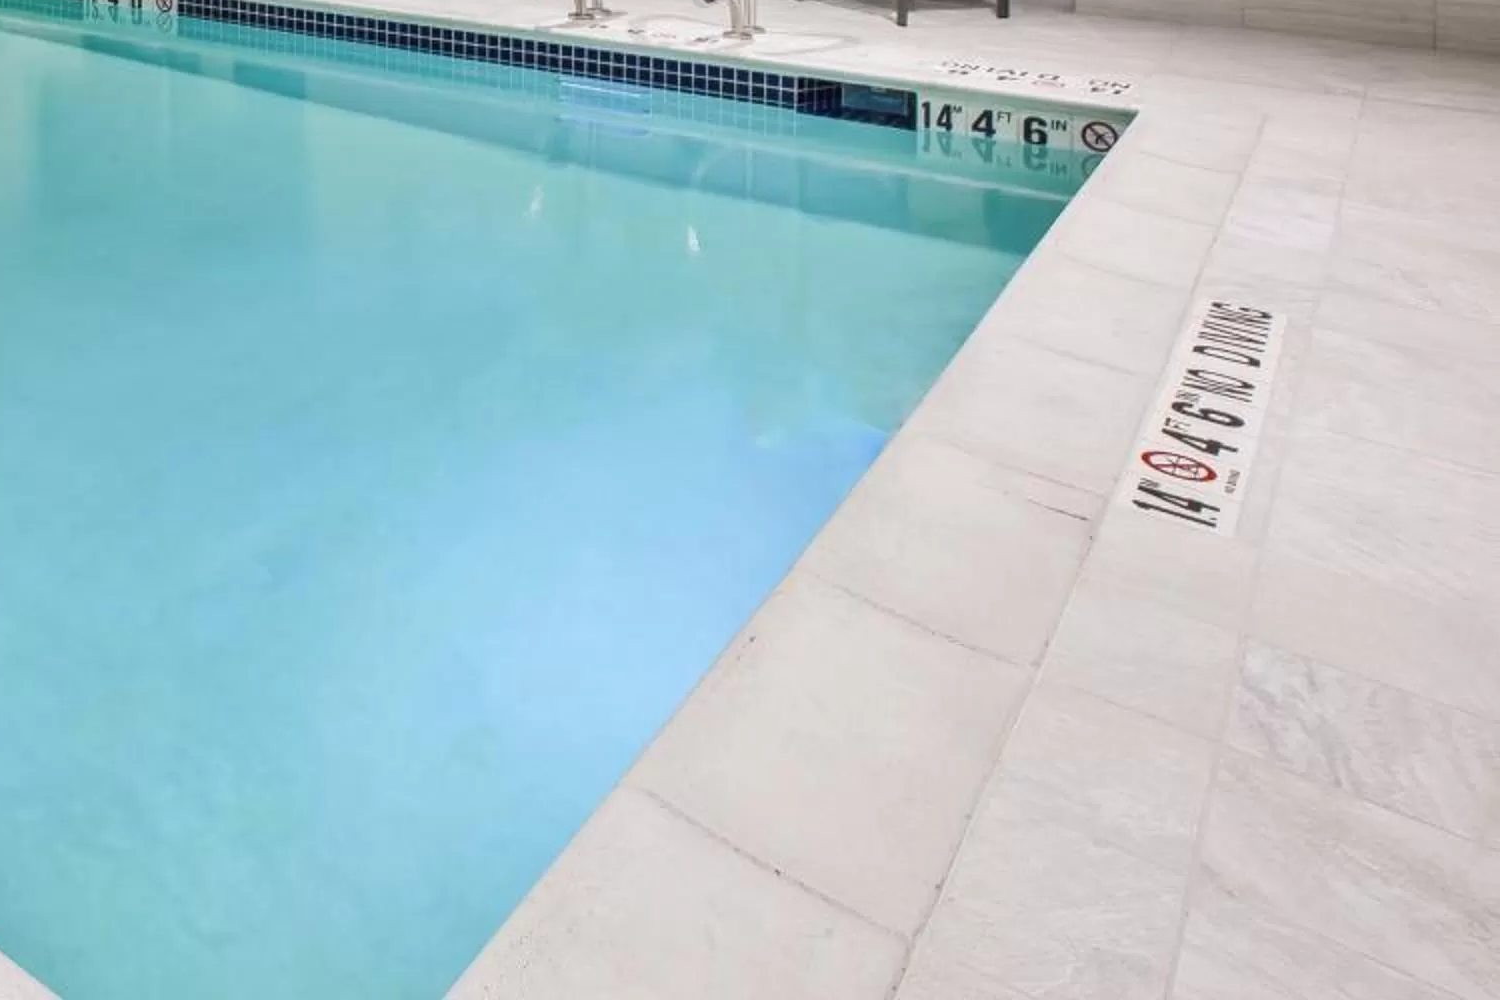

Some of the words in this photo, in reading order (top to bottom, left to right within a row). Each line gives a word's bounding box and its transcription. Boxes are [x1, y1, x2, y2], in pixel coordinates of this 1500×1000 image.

[971, 110, 996, 138] 4
[1023, 116, 1048, 145] 6
[1192, 302, 1273, 368] DIVING
[1181, 368, 1255, 403] NO
[1171, 401, 1245, 428] 6
[1161, 428, 1239, 456] 4
